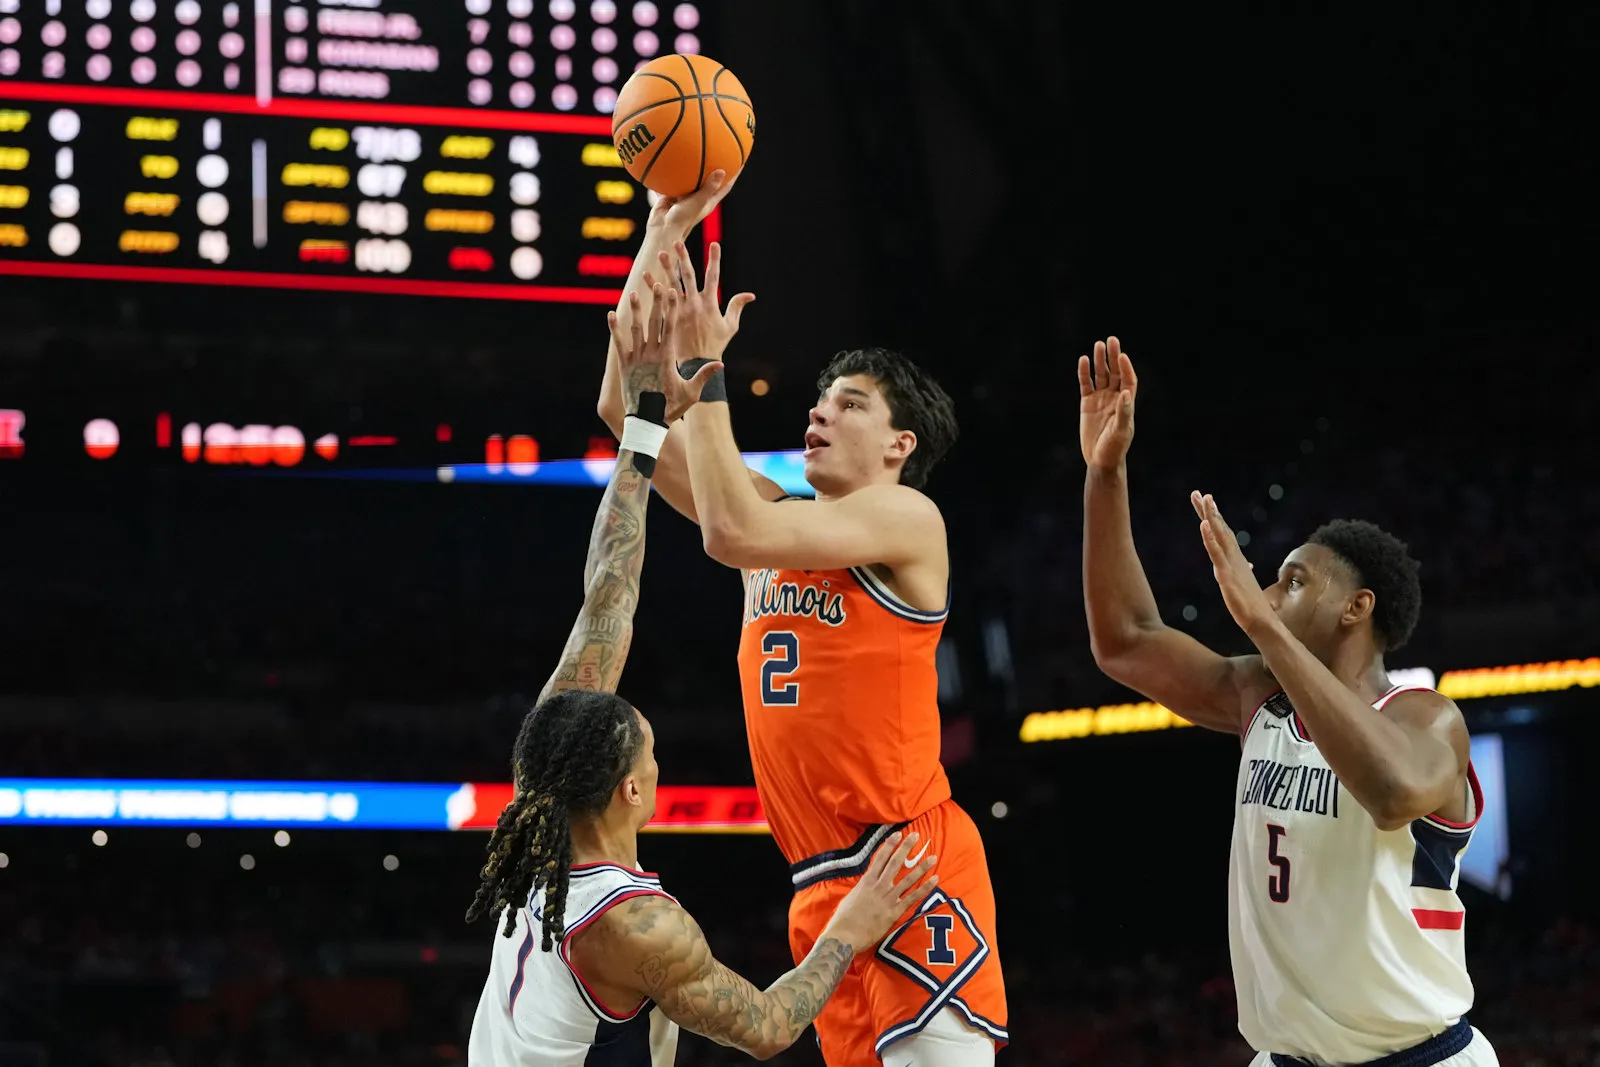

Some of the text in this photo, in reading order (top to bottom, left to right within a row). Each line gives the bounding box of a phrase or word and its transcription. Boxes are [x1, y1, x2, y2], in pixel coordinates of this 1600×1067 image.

[760, 630, 800, 707] 2
[1266, 823, 1291, 904] 5
[924, 914, 956, 966] I
